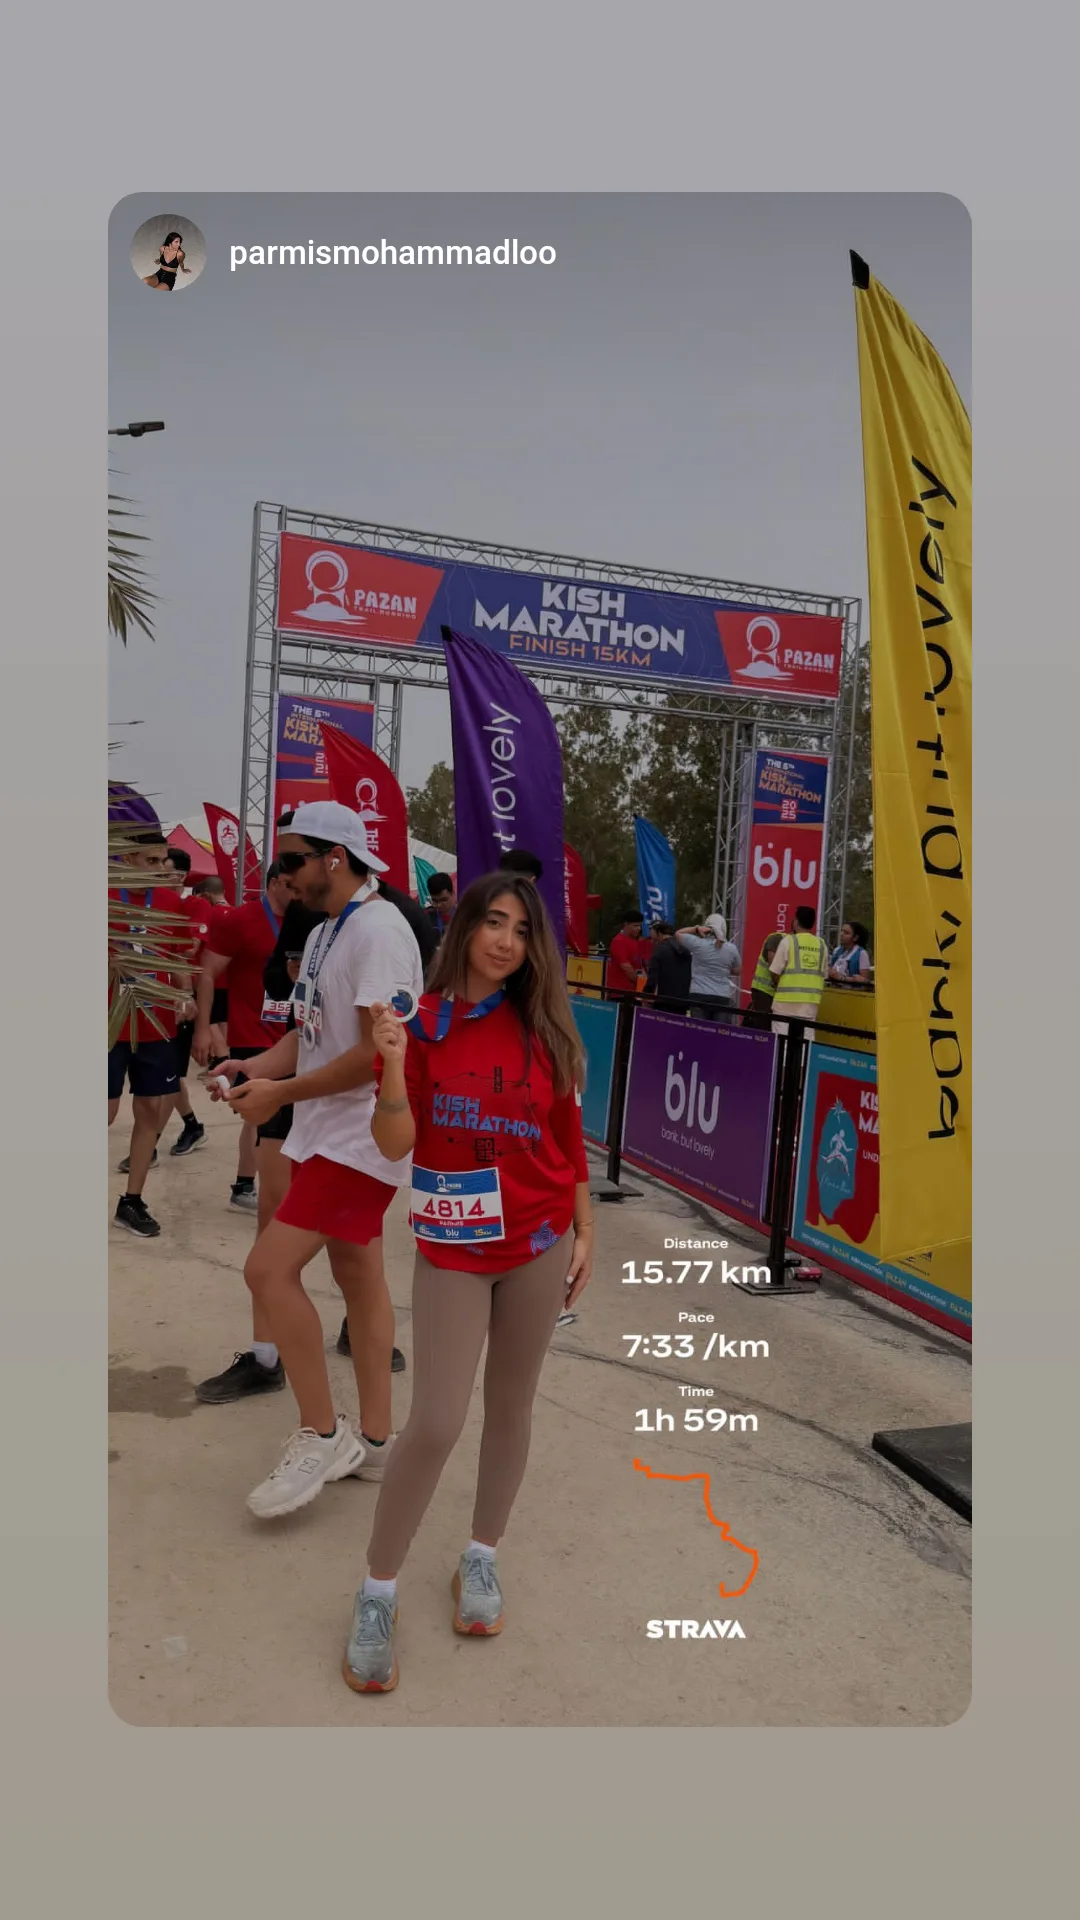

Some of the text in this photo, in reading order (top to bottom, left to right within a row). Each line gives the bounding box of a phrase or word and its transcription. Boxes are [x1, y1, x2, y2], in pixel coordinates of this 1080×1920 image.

[354, 589, 417, 614] PAZAN
[542, 581, 626, 618] KISH
[474, 598, 685, 657] MARATHON
[509, 633, 651, 667] FINISH 15KM
[783, 648, 835, 669] PAZAN
[292, 704, 313, 716] THE
[286, 716, 320, 736] KISH
[482, 702, 521, 821] lovely
[766, 757, 782, 769] THE
[761, 769, 787, 785] KISH
[758, 780, 822, 804] MARATHON
[781, 809, 797, 820] 25
[782, 799, 797, 810] 20
[753, 842, 817, 890] blu
[433, 1093, 481, 1114] KISH
[664, 1051, 721, 1134] blu
[433, 1112, 541, 1139] MARATHON
[680, 1132, 693, 1151] but
[693, 1138, 715, 1161] lovely
[423, 1197, 485, 1218] 4814
[445, 1228, 460, 1237] blu
